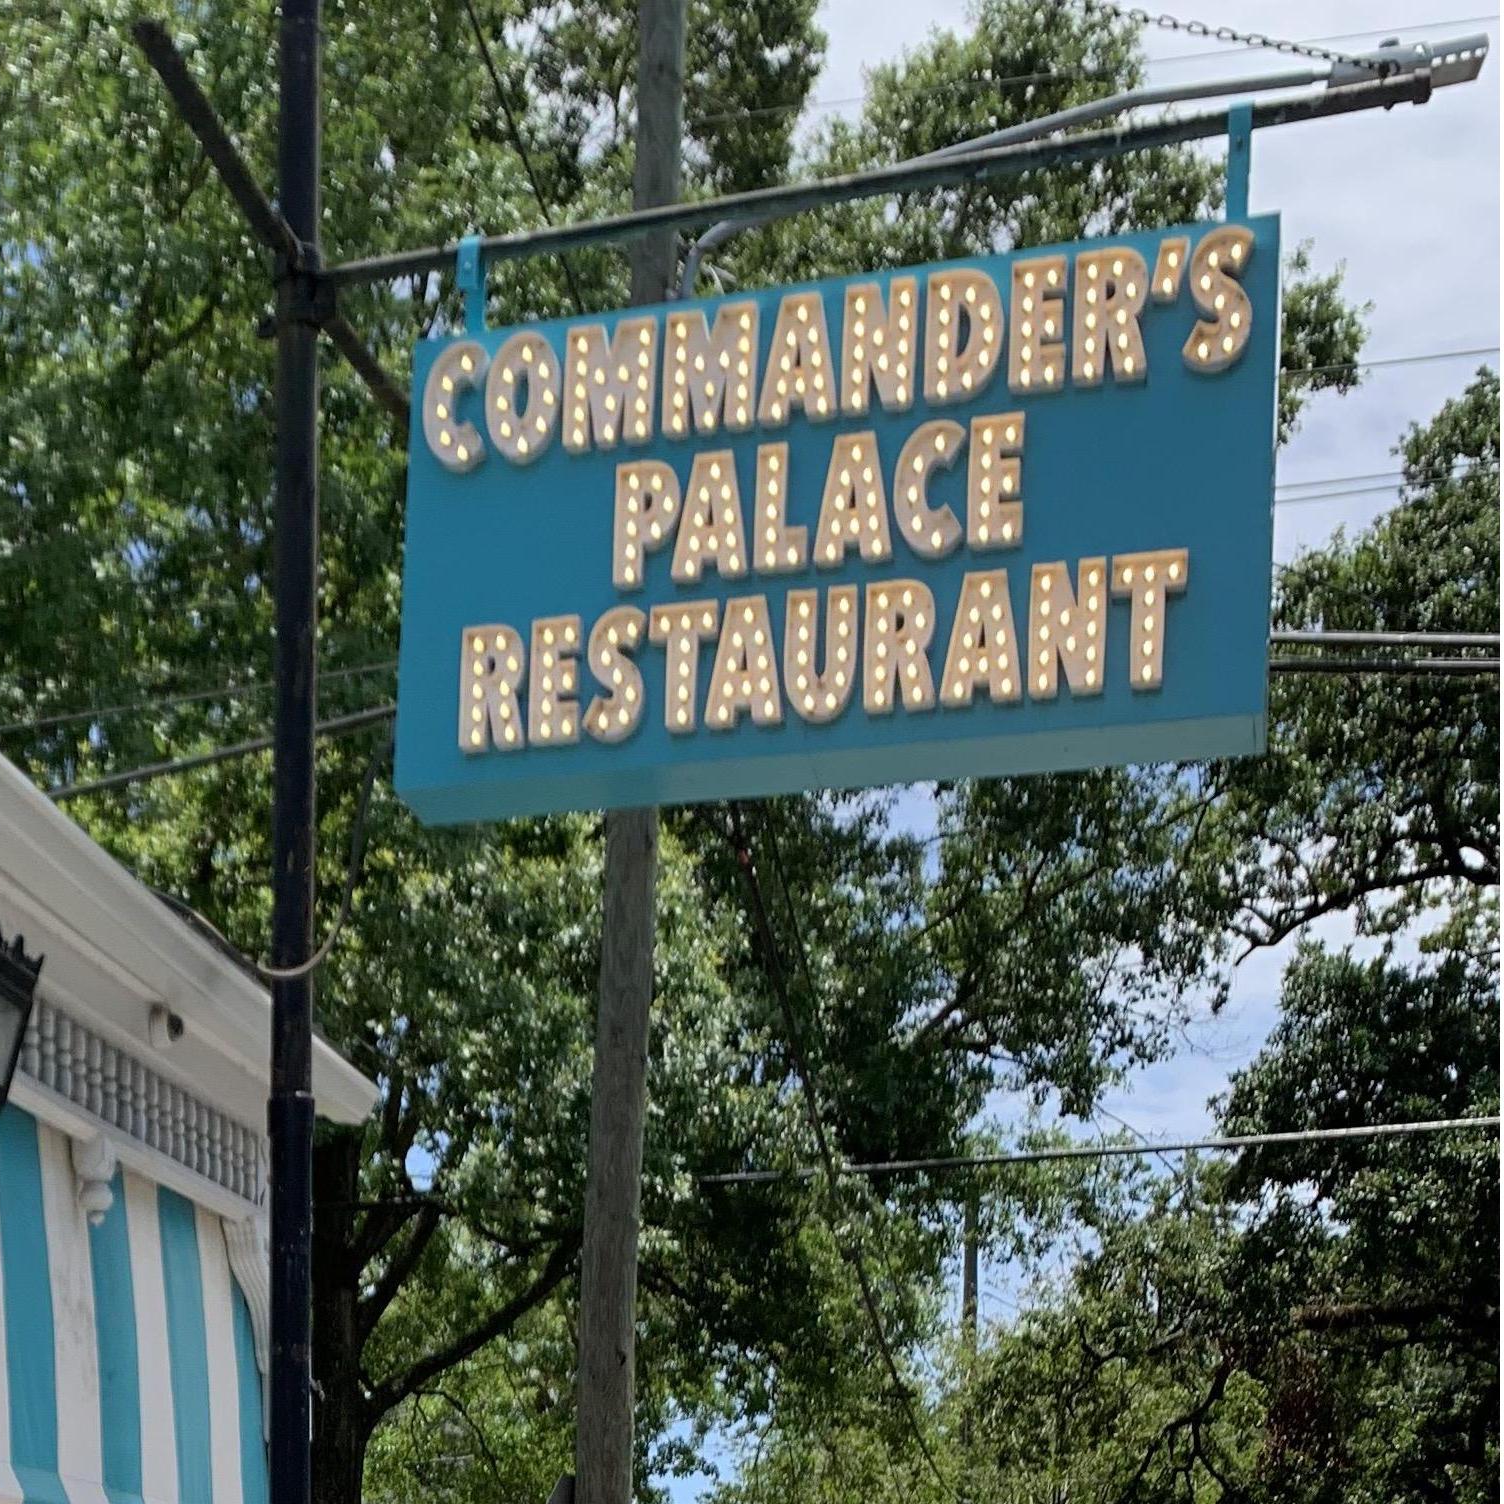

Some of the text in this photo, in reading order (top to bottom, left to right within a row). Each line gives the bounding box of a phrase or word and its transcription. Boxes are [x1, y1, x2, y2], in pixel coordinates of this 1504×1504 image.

[422, 224, 1255, 473] COMMANDER'S
[611, 411, 1026, 589] PALACE
[456, 548, 1189, 754] RESTAURANT
